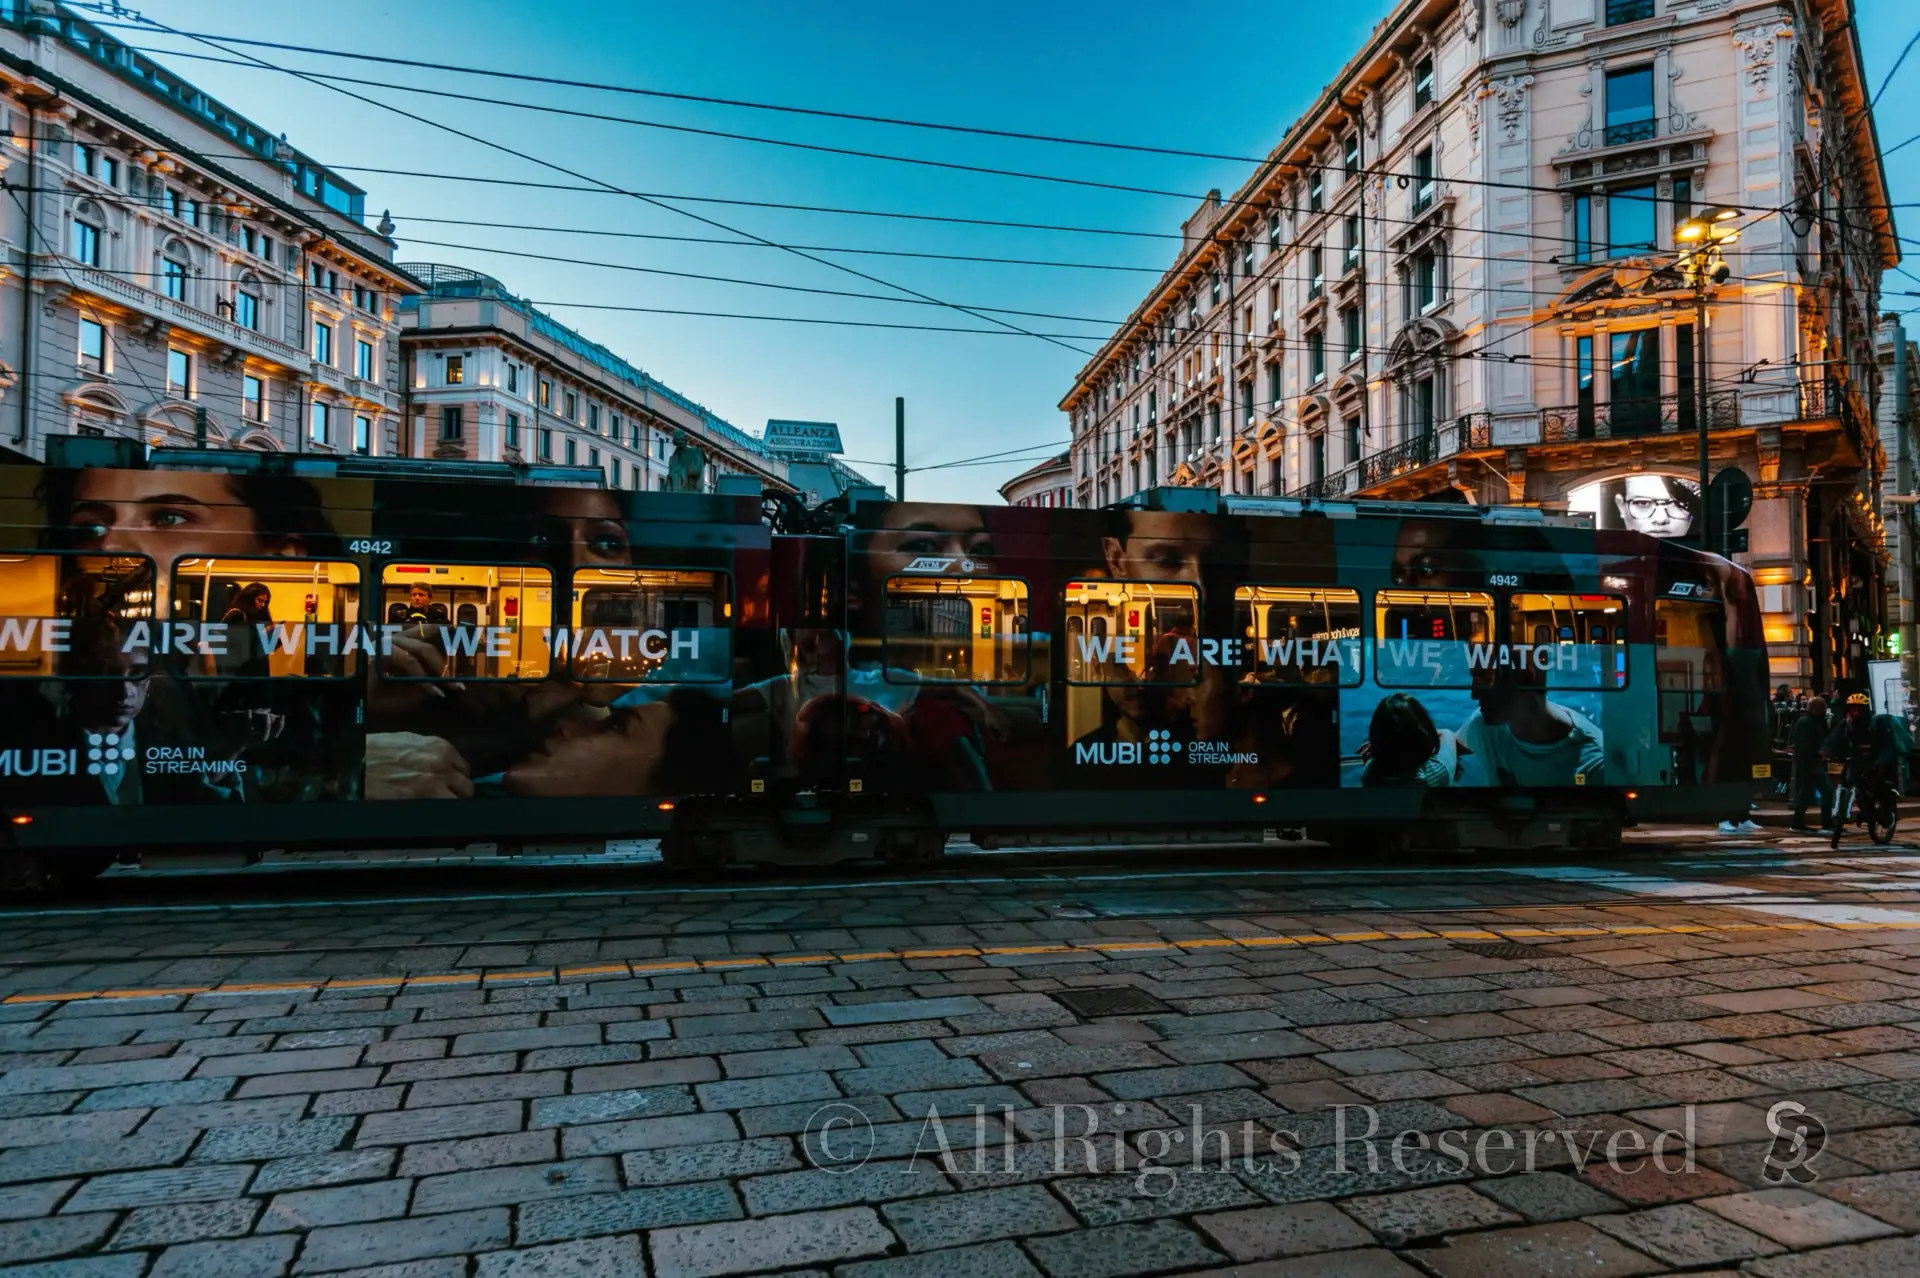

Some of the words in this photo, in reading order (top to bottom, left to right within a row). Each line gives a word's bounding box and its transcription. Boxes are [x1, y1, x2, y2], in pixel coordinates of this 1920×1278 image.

[769, 425, 835, 438] ALLEANZA
[769, 437, 836, 449] ASSICURAZIONI
[349, 540, 392, 554] 4942
[919, 560, 940, 569] ATM
[1489, 574, 1518, 587] 4942
[121, 621, 228, 655] ARE
[256, 623, 403, 656] WHAT
[438, 626, 512, 657] WE
[543, 627, 700, 660] WATCH
[1077, 635, 1136, 664] WE
[1169, 638, 1242, 666] ARE
[1260, 639, 1361, 666] WHAT
[1388, 641, 1441, 668] WE
[1463, 643, 1578, 671] WATCH
[145, 747, 183, 760] ORA
[187, 747, 205, 760] IN
[1075, 742, 1142, 765] MUBI
[1188, 741, 1214, 753] ORA
[1216, 741, 1229, 753] IN
[1188, 753, 1258, 765] STREAMING
[145, 760, 248, 774] STREAMING
